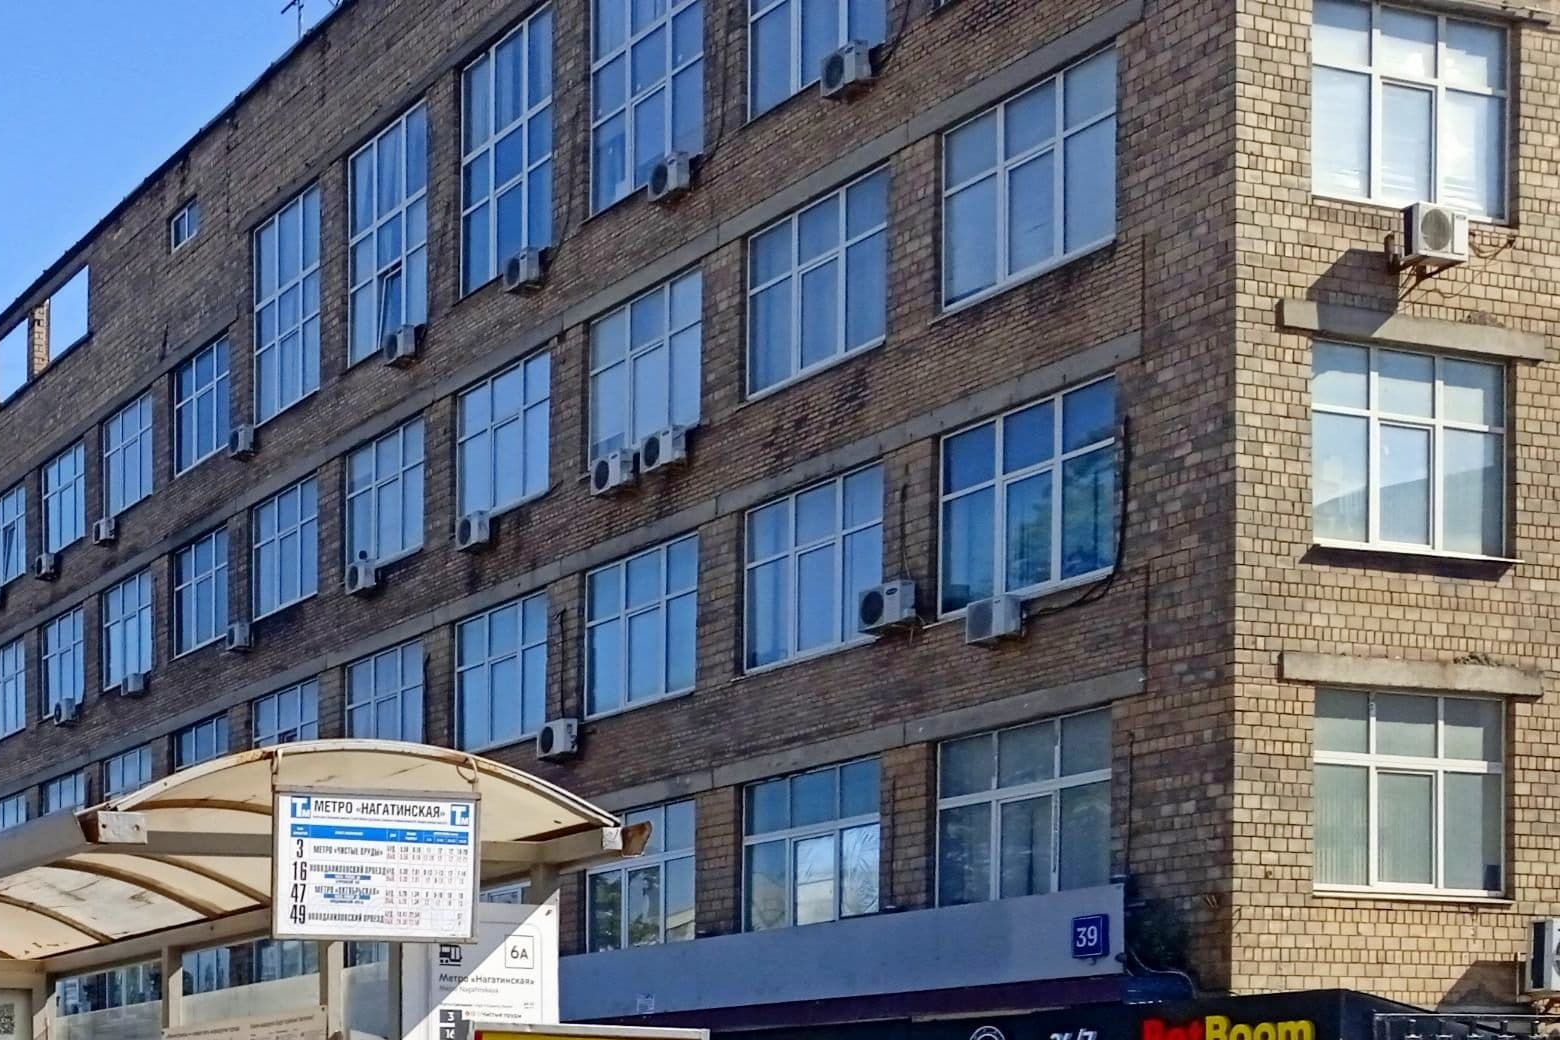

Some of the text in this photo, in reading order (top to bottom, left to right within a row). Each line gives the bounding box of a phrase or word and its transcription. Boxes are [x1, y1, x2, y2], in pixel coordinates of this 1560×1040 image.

[314, 800, 446, 818] МЕТРО «НАГАТИНСКАЯ»
[296, 839, 304, 858] 3
[293, 861, 307, 881] 16
[291, 883, 306, 903] 47
[290, 904, 306, 924] 49
[1076, 926, 1098, 947] 39
[510, 945, 529, 960] 6А
[439, 973, 469, 984] Метро
[447, 1011, 455, 1021] 3
